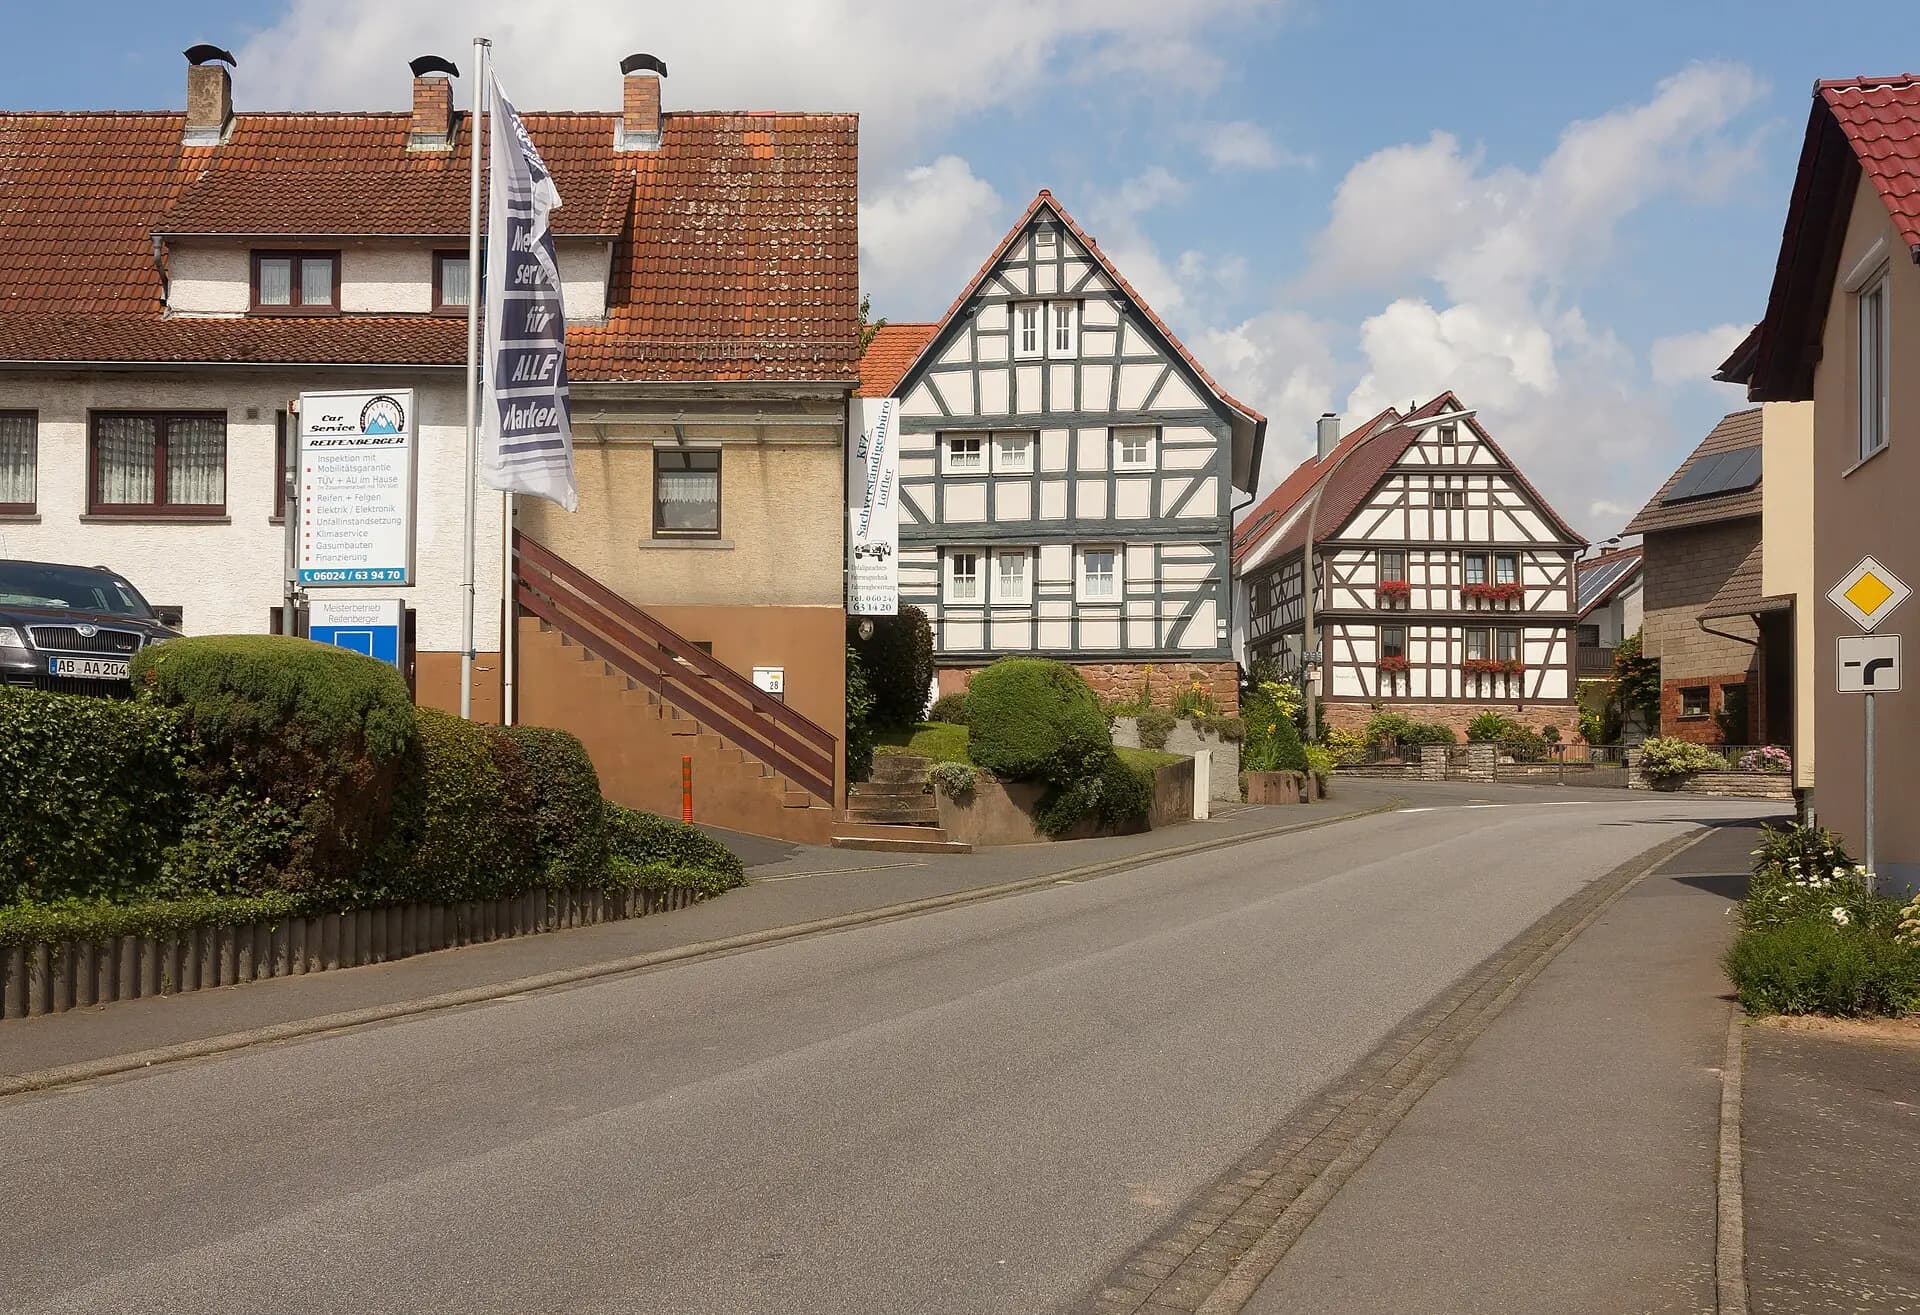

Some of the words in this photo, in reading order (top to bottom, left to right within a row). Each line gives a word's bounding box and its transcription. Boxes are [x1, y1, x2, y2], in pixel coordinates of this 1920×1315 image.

[524, 306, 555, 333] für
[511, 354, 557, 381] ALLE
[503, 402, 558, 432] Marken
[310, 423, 355, 432] Service
[310, 438, 404, 446] REIFENBERGER
[317, 454, 360, 463] Inspektion
[317, 464, 391, 473] Mobilitätsgarantie
[857, 400, 890, 538] Sachverständigenbüro
[317, 475, 334, 485] TÜV
[345, 476, 357, 484] AU
[359, 475, 370, 484] im
[372, 475, 398, 483] Hause
[317, 494, 342, 502] Reifen
[354, 493, 381, 503] Felgen
[317, 506, 347, 514] Elektrik
[356, 505, 395, 513] Elektronik
[316, 517, 402, 526] Unfallinstandsetzung
[316, 541, 373, 550] Gasumbauten
[315, 553, 367, 562] Finanzierung
[313, 571, 346, 581] 06024
[355, 571, 368, 580] 63
[370, 571, 384, 580] 94
[387, 570, 401, 580] 70
[323, 603, 381, 613] Meisterbetrieb
[328, 614, 379, 625] Reifenberger
[59, 661, 74, 672] AB
[84, 662, 100, 674] AA
[103, 663, 126, 676] 204
[769, 680, 779, 690] 28
